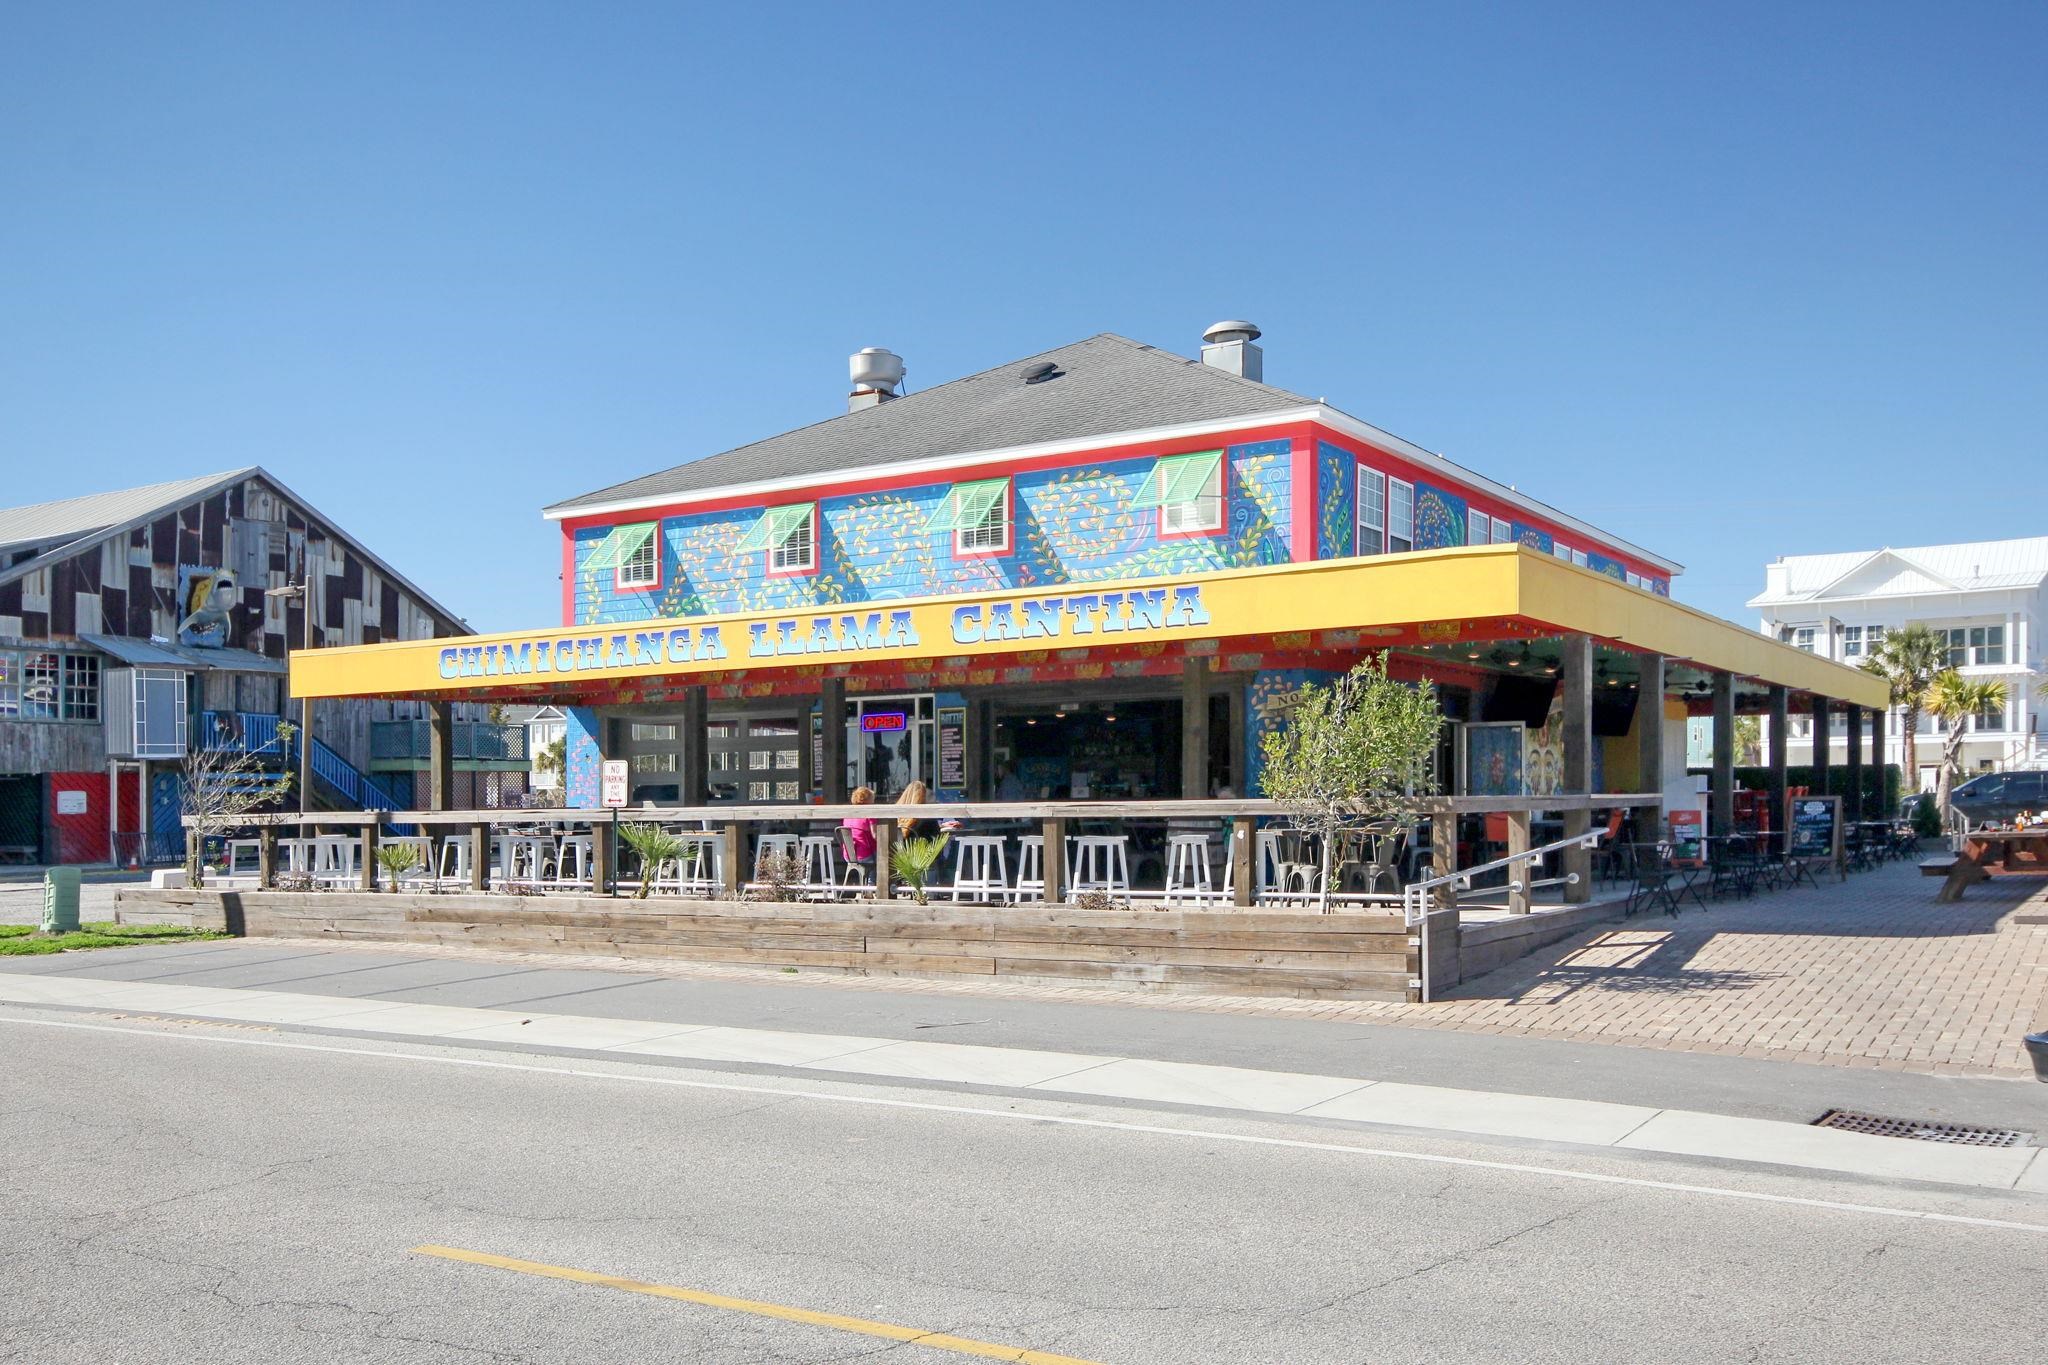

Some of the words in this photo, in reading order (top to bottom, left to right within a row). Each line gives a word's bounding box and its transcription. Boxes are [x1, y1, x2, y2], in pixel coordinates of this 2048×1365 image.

[438, 626, 728, 680] CHIMICHANGA
[748, 611, 920, 658] LLAMA
[951, 586, 1211, 645] CANTINA
[1278, 692, 1299, 706] NO
[864, 716, 902, 729] OPEN
[611, 765, 620, 774] NO
[605, 775, 625, 783] PARKING
